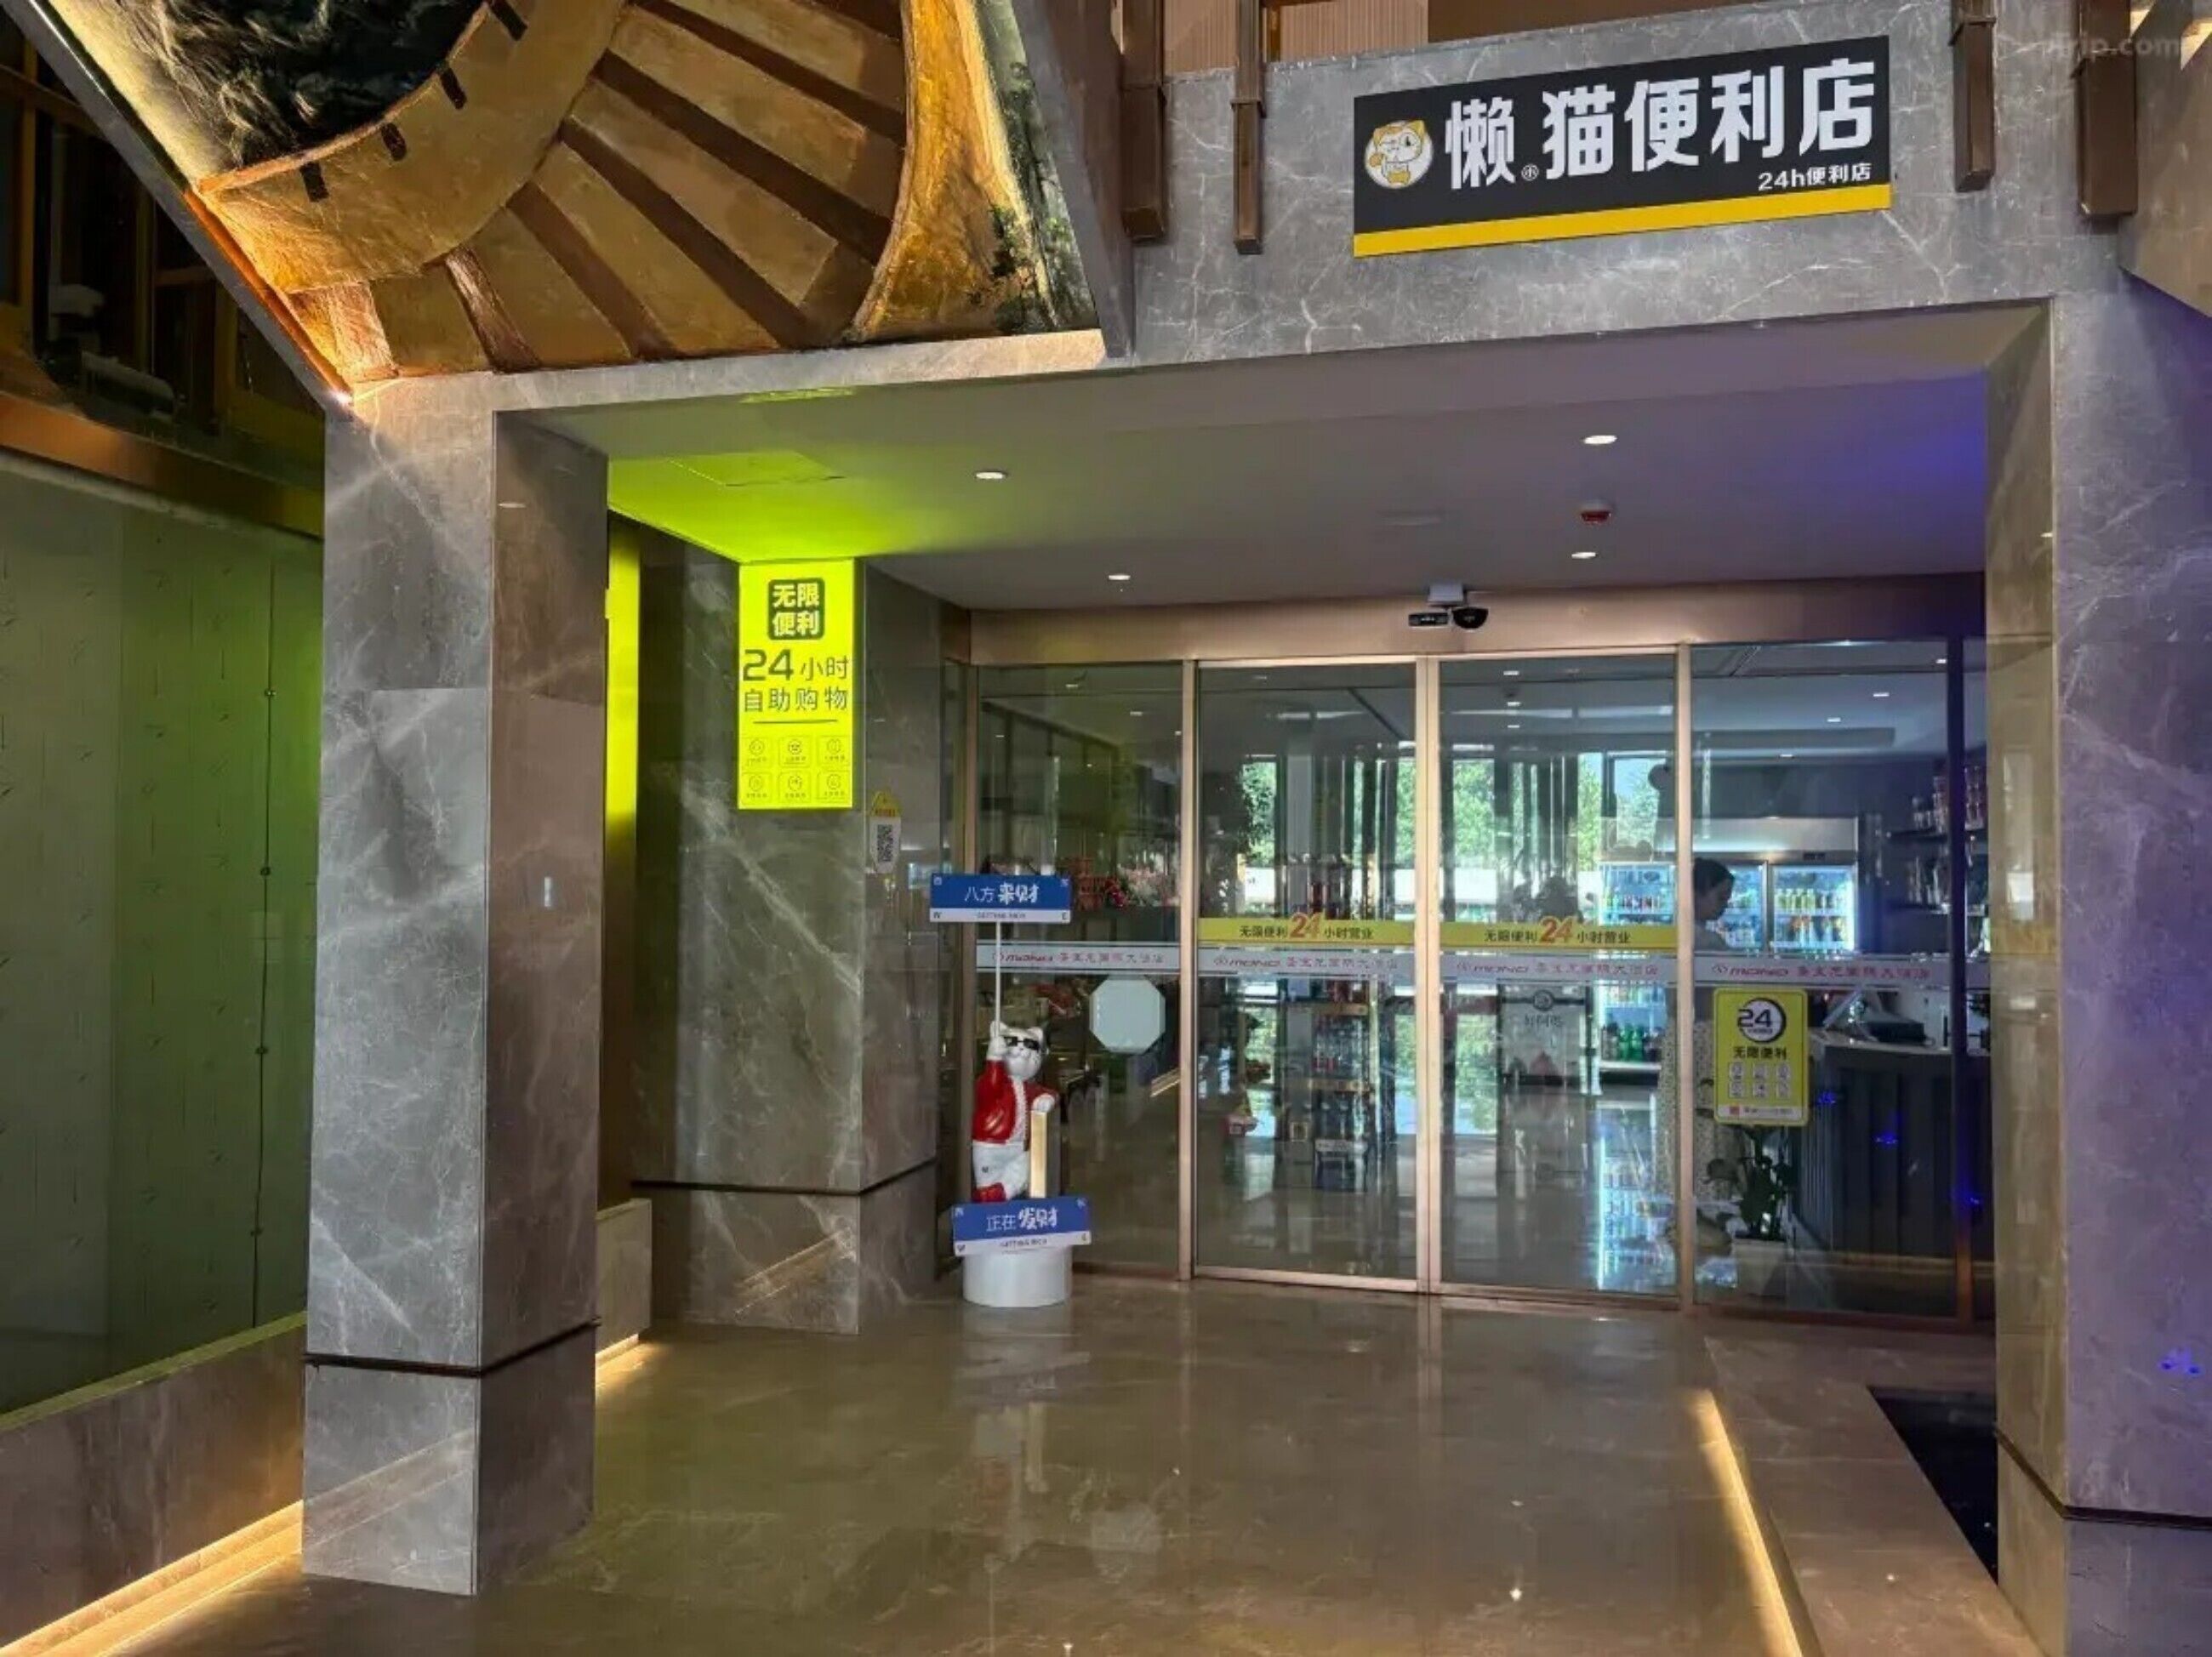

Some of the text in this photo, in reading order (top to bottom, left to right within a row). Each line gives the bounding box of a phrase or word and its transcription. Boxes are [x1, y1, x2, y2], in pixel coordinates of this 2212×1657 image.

[1758, 162, 1872, 191] 24h便利店
[772, 583, 820, 608] 无限
[772, 611, 820, 638] 便利
[743, 687, 848, 713] 自助购物
[1736, 1009, 1771, 1028] 24
